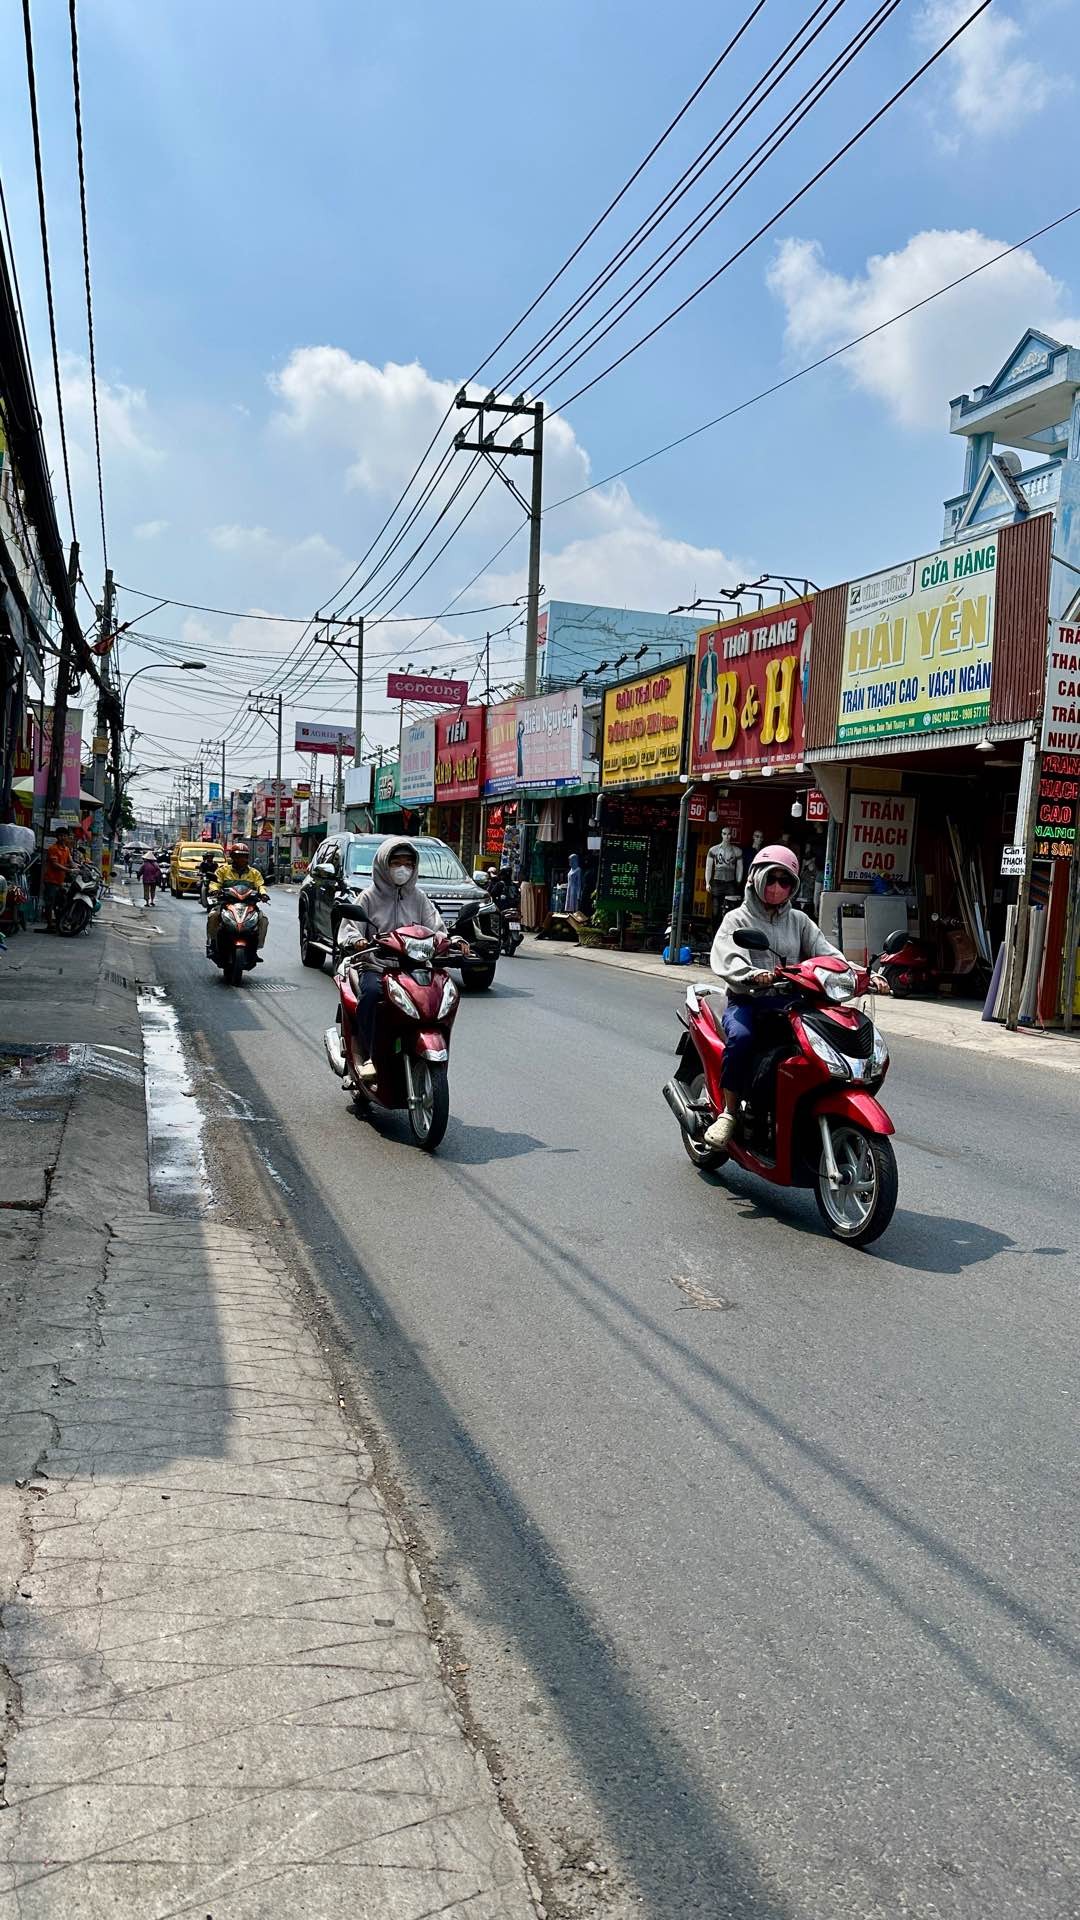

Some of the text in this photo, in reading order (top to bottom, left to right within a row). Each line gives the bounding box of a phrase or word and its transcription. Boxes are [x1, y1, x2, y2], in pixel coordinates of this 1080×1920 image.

[921, 545, 996, 588] CỬA HÀNG
[723, 618, 798, 660] THỜI TRANG
[848, 587, 991, 677] HẢI YẾN
[1052, 653, 1080, 674] THẠ
[711, 655, 798, 752] B & H
[842, 679, 864, 714] TRẦN
[867, 681, 897, 712] THẠCH
[899, 676, 918, 704] CAO
[928, 666, 956, 698] VÁCH
[959, 659, 992, 692] NGĂN
[853, 824, 908, 846] THẠCH
[861, 851, 896, 871] CAO
